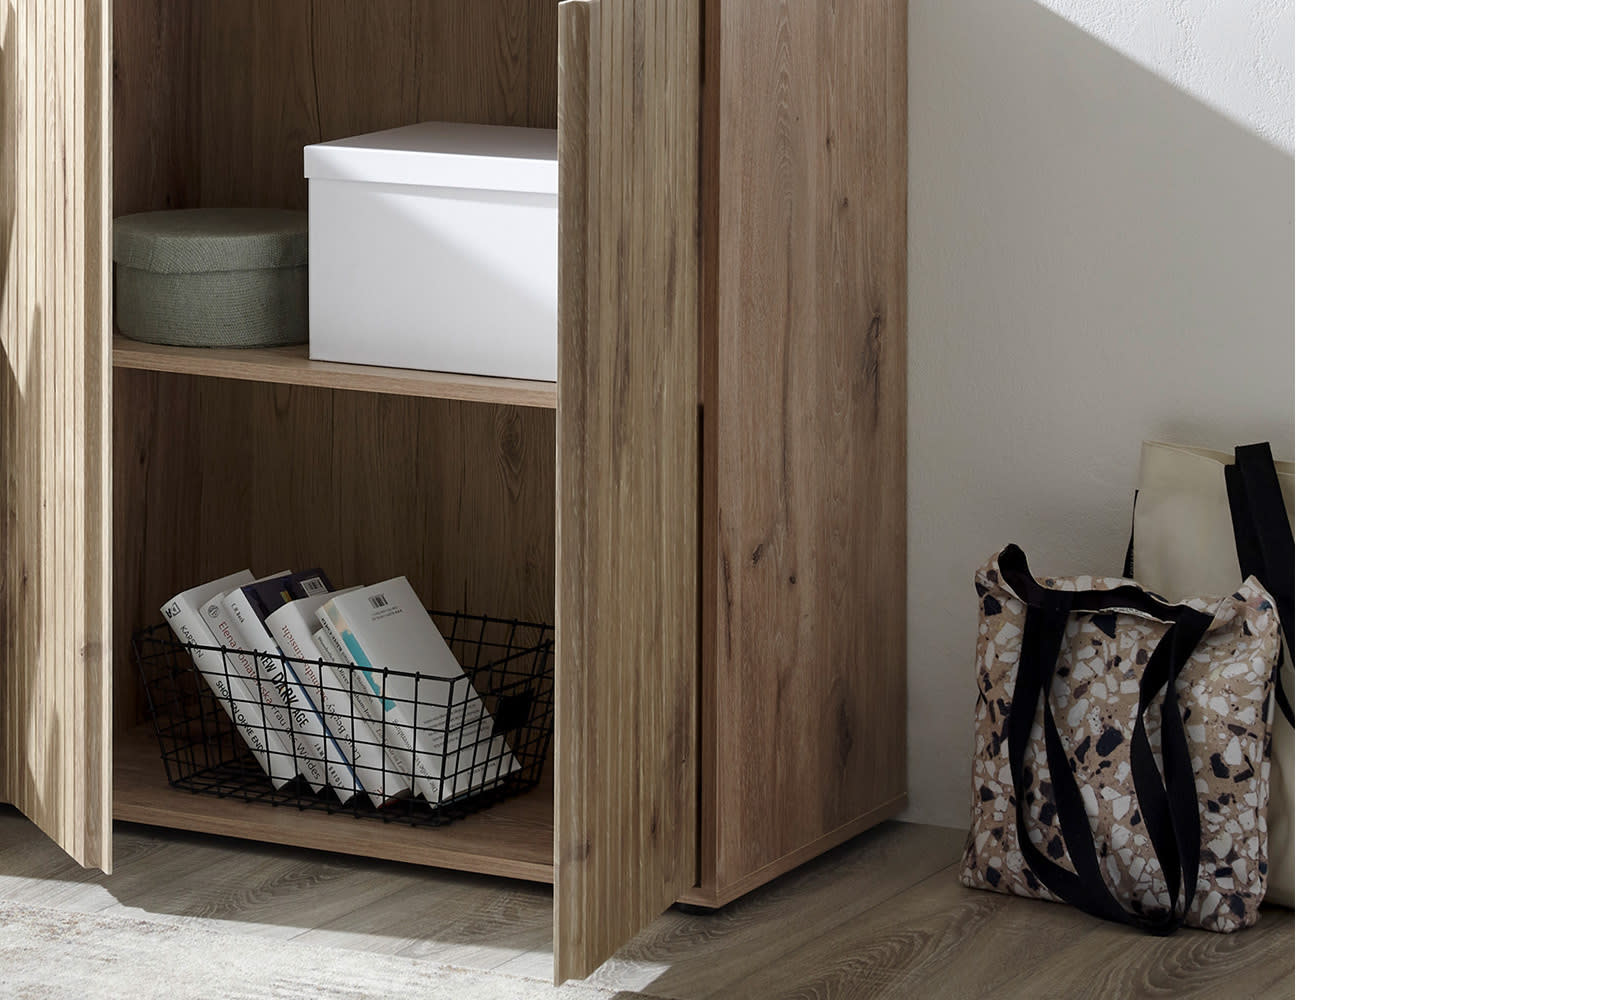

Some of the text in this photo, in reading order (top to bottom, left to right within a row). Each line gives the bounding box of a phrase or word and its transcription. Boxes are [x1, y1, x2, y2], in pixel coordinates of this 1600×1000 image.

[214, 679, 240, 714] SHOEN
[217, 621, 239, 648] Elena
[233, 646, 276, 706] oniatska
[257, 650, 310, 729] NEW DARK AGE
